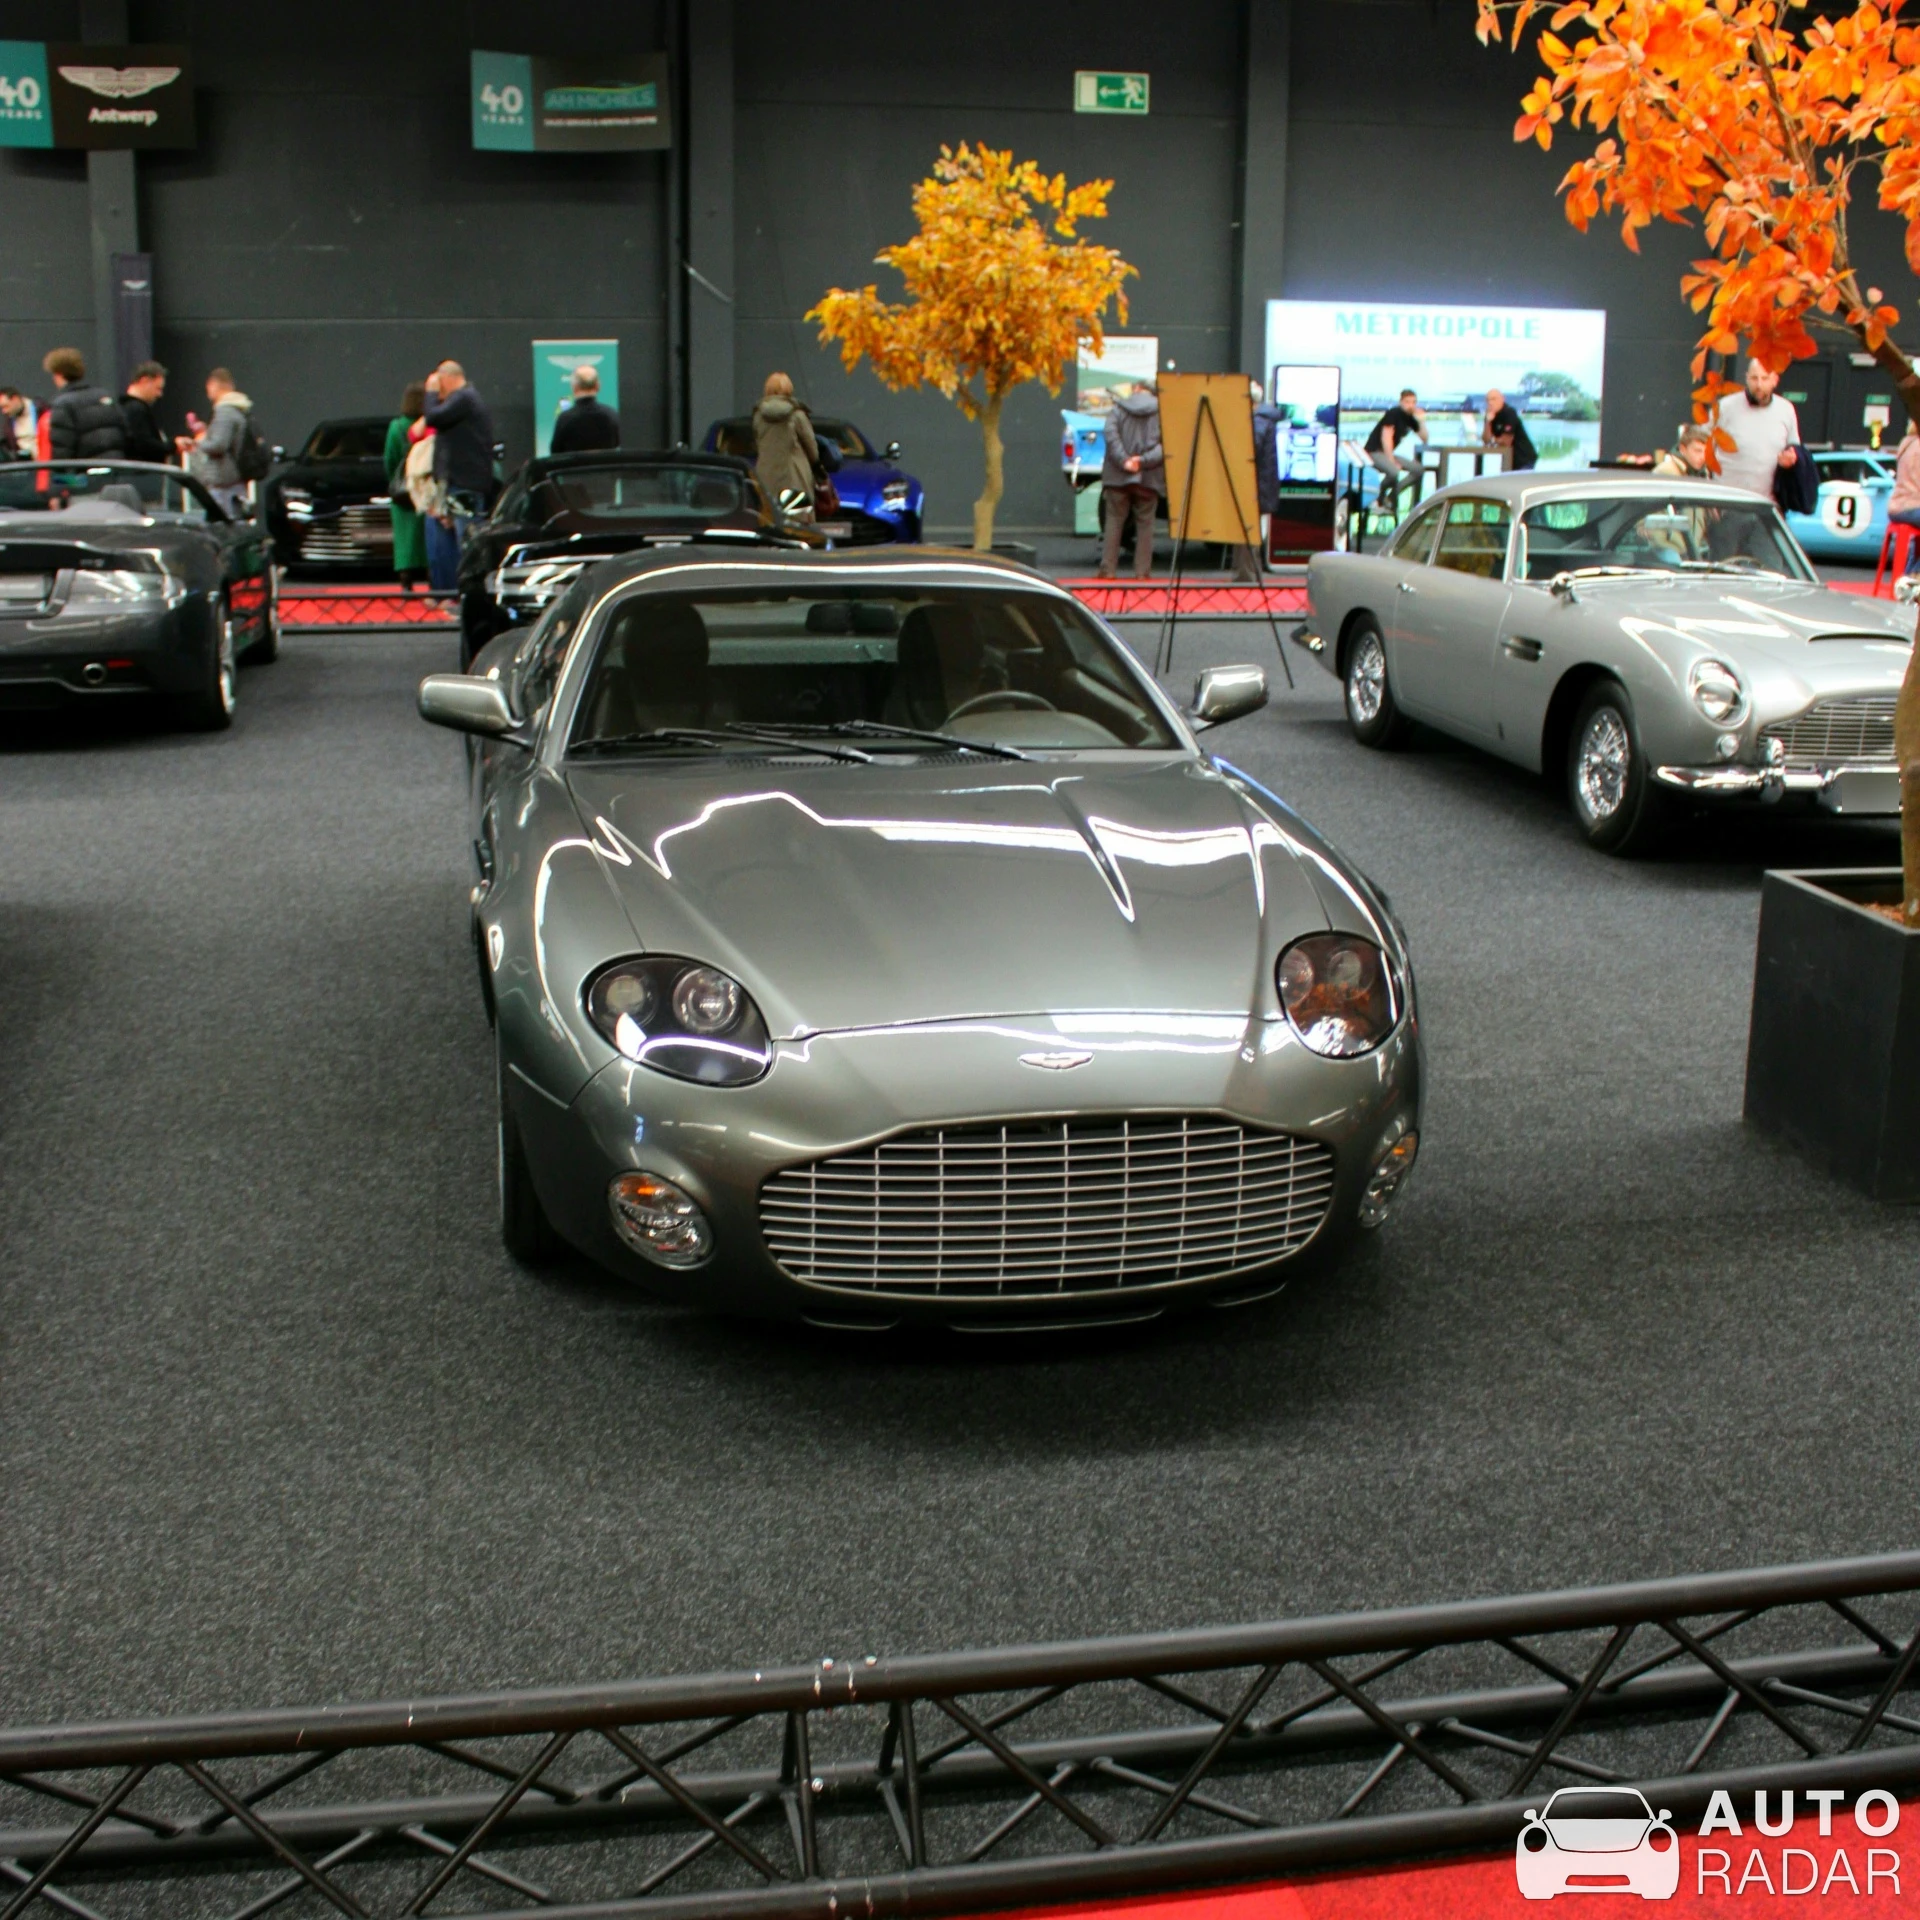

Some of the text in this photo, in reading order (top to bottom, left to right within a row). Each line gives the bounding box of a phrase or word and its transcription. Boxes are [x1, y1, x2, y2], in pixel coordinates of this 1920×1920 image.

[0, 76, 41, 108] 40
[480, 84, 524, 113] 40
[88, 107, 159, 127] Antwerp
[480, 114, 525, 125] YEARS
[1335, 311, 1540, 339] METROPOLE
[1836, 496, 1856, 529] 9
